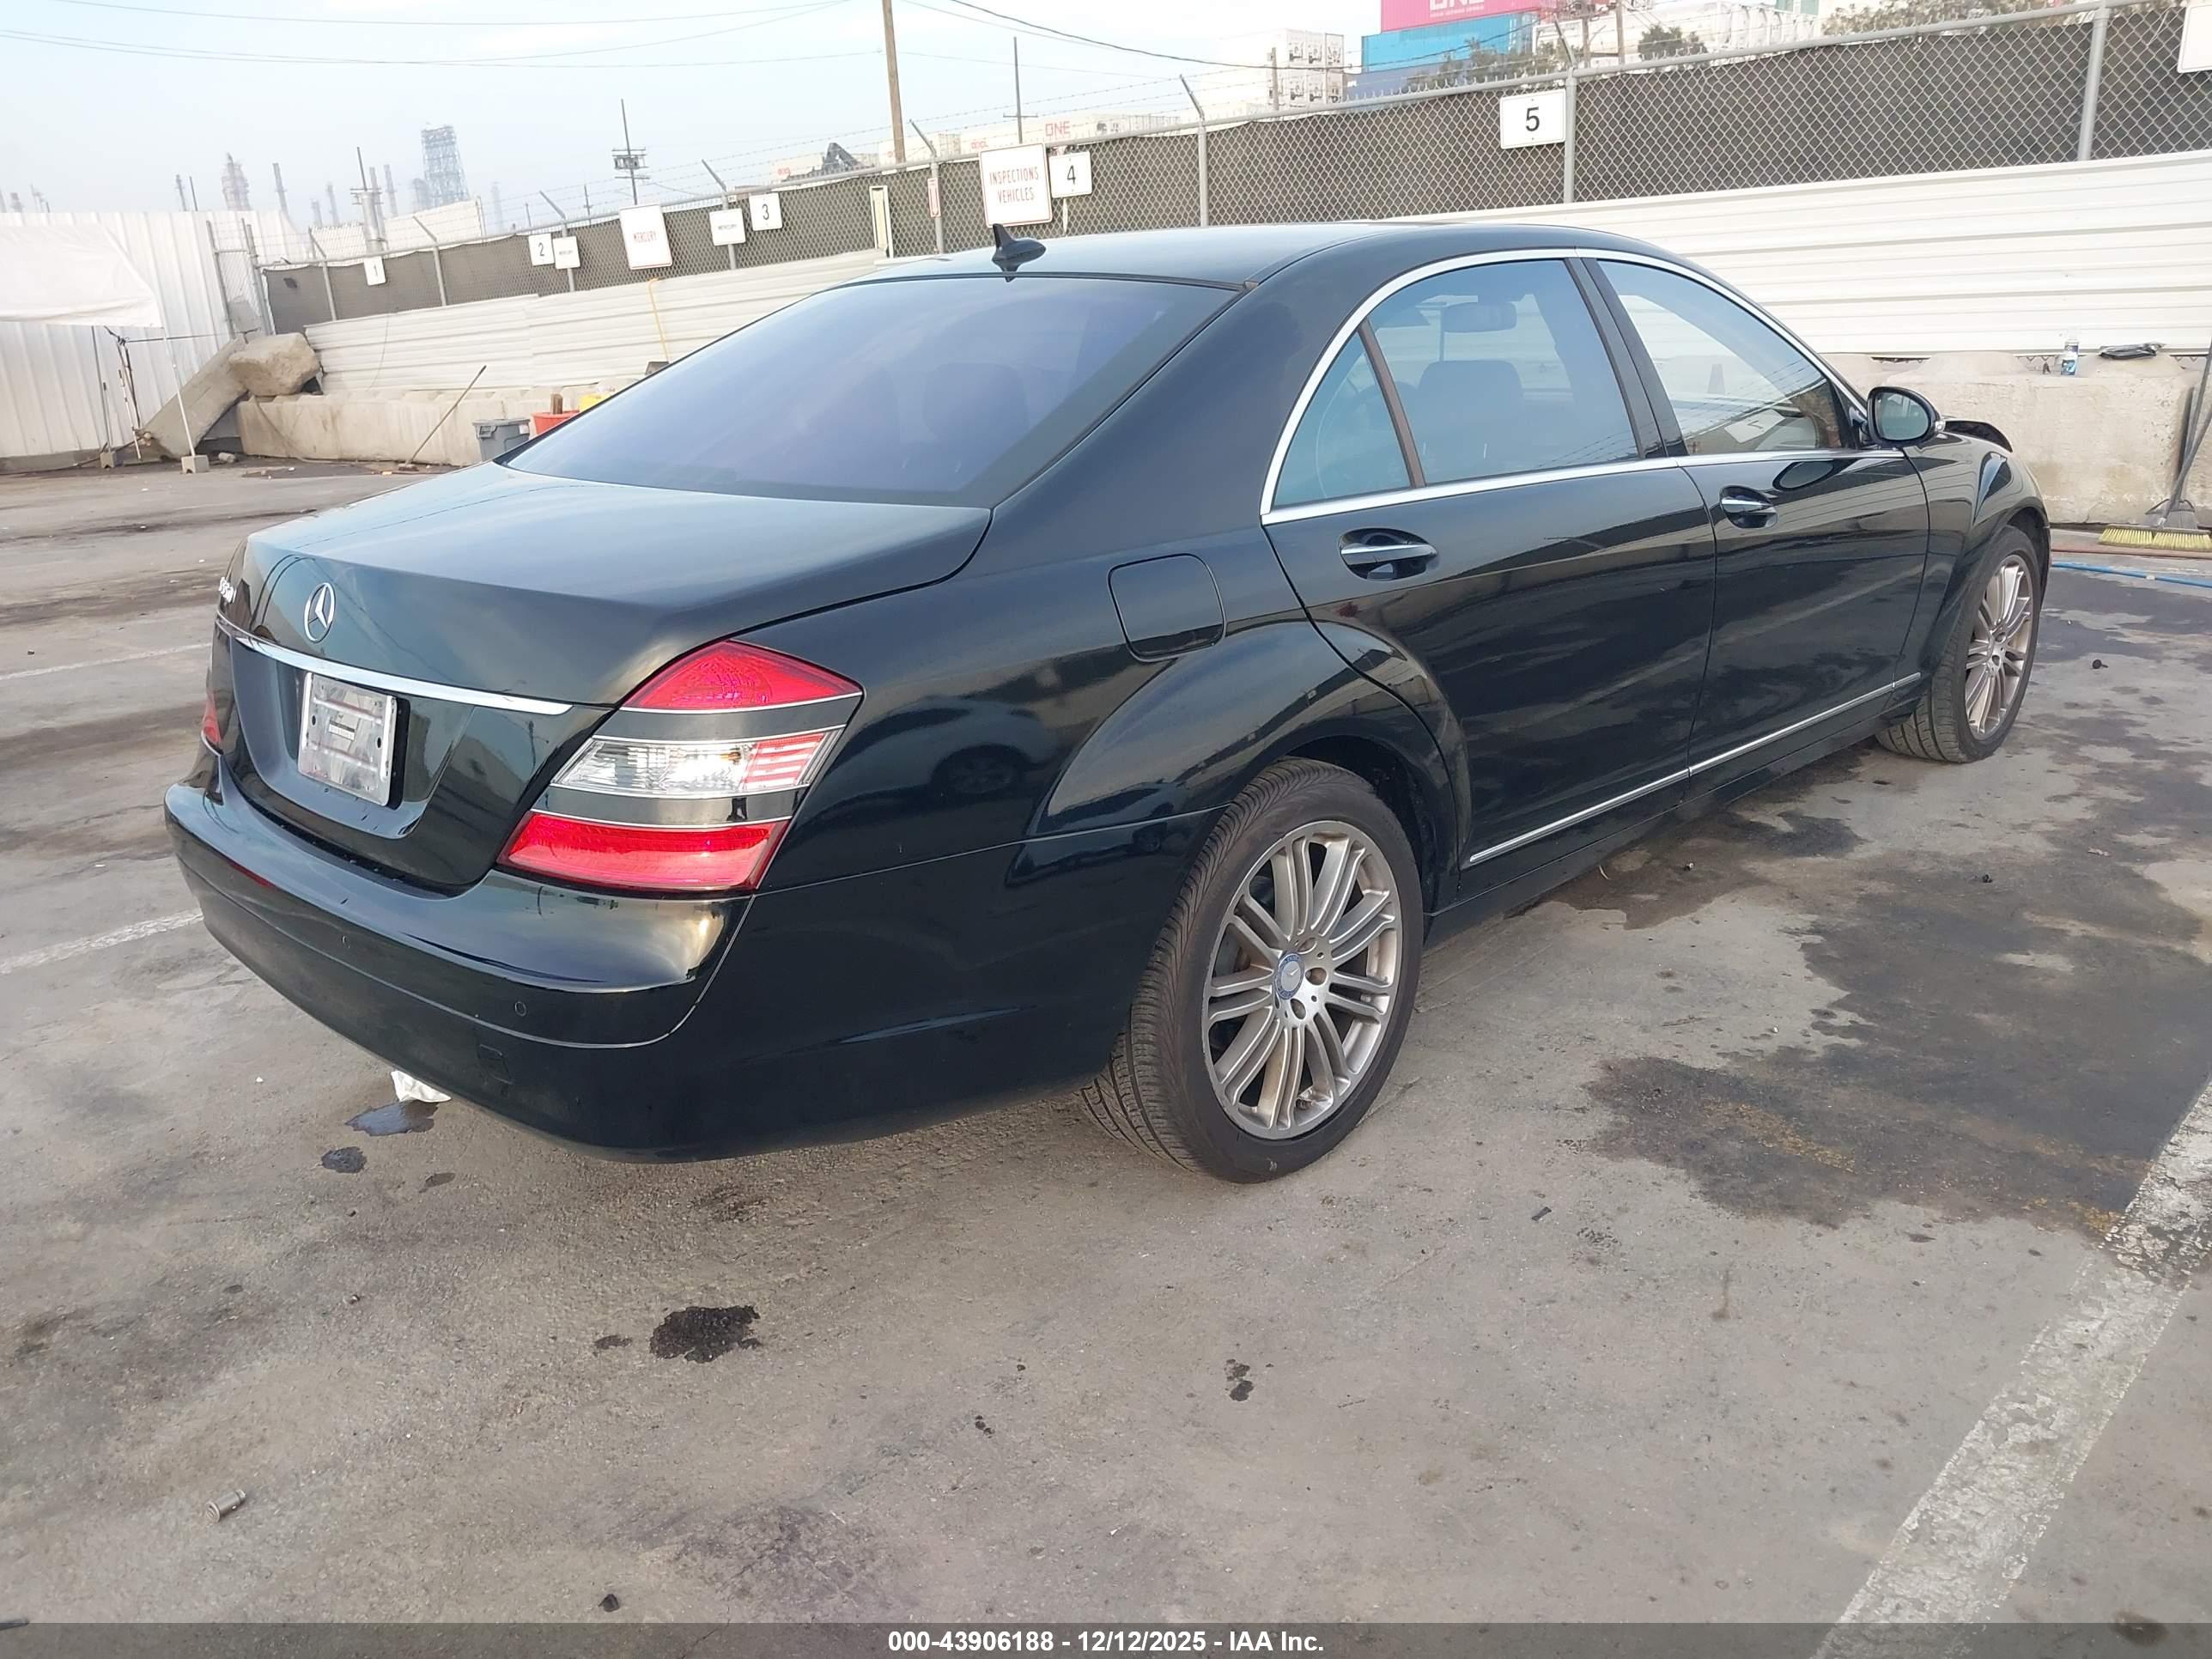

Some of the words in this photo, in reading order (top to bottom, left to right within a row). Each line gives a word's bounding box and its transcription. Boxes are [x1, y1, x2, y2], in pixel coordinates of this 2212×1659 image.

[1525, 106, 1540, 132] 5
[1045, 121, 1070, 137] ONE
[989, 167, 1039, 186] INSPECTIONS
[1066, 164, 1077, 185] 4
[997, 186, 1035, 204] VEHICLES
[762, 203, 769, 221] 3
[538, 241, 545, 257] 2
